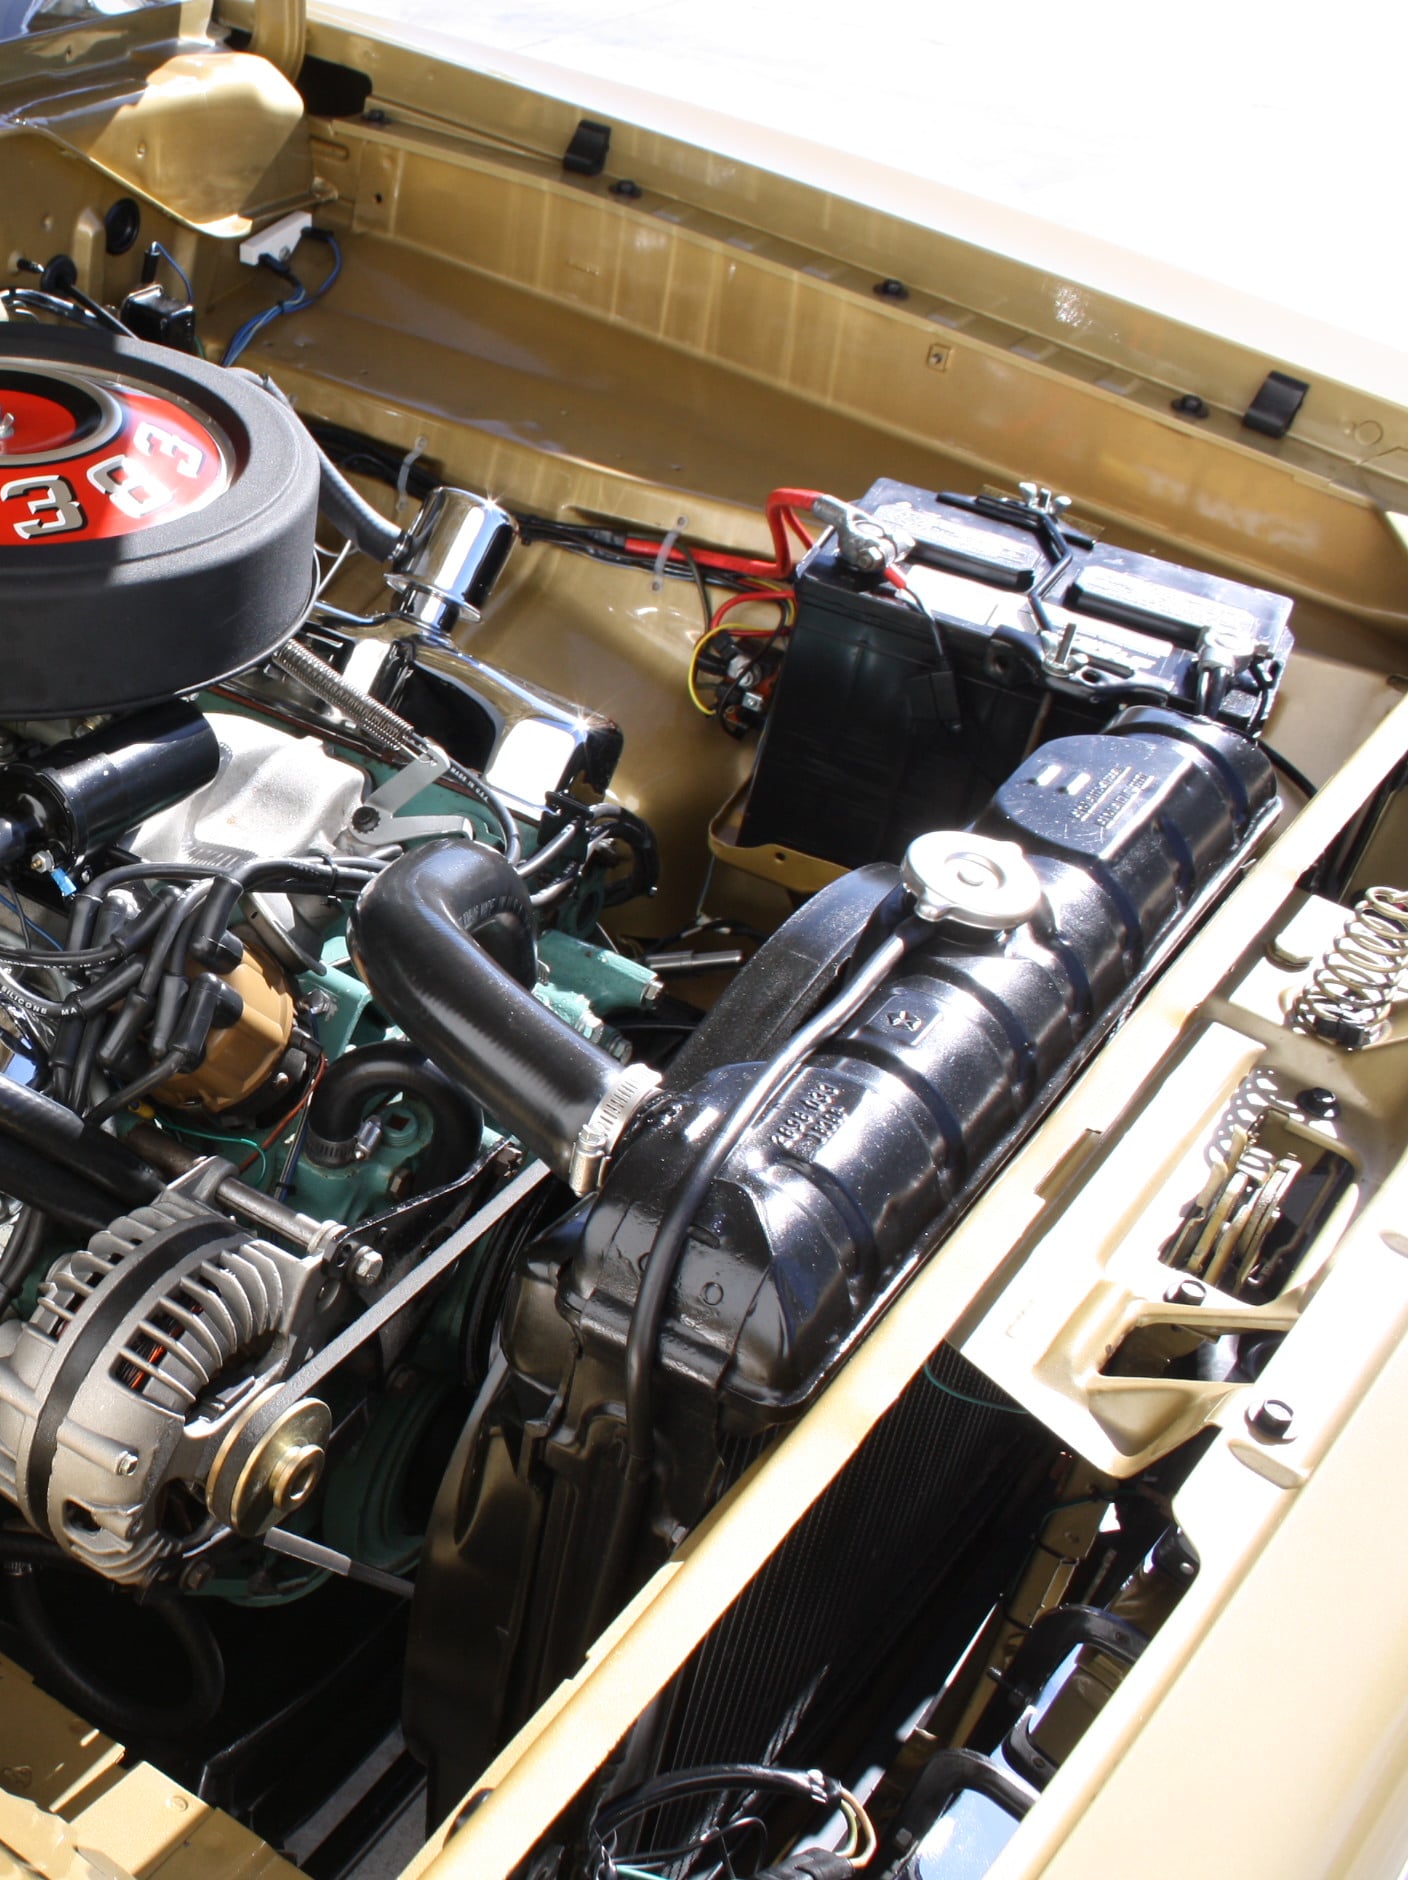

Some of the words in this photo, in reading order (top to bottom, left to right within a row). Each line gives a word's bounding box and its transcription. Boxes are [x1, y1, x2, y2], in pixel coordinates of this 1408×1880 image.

[0, 421, 206, 540] 383
[0, 984, 49, 1015] SILICONE
[61, 1006, 79, 1017] MA
